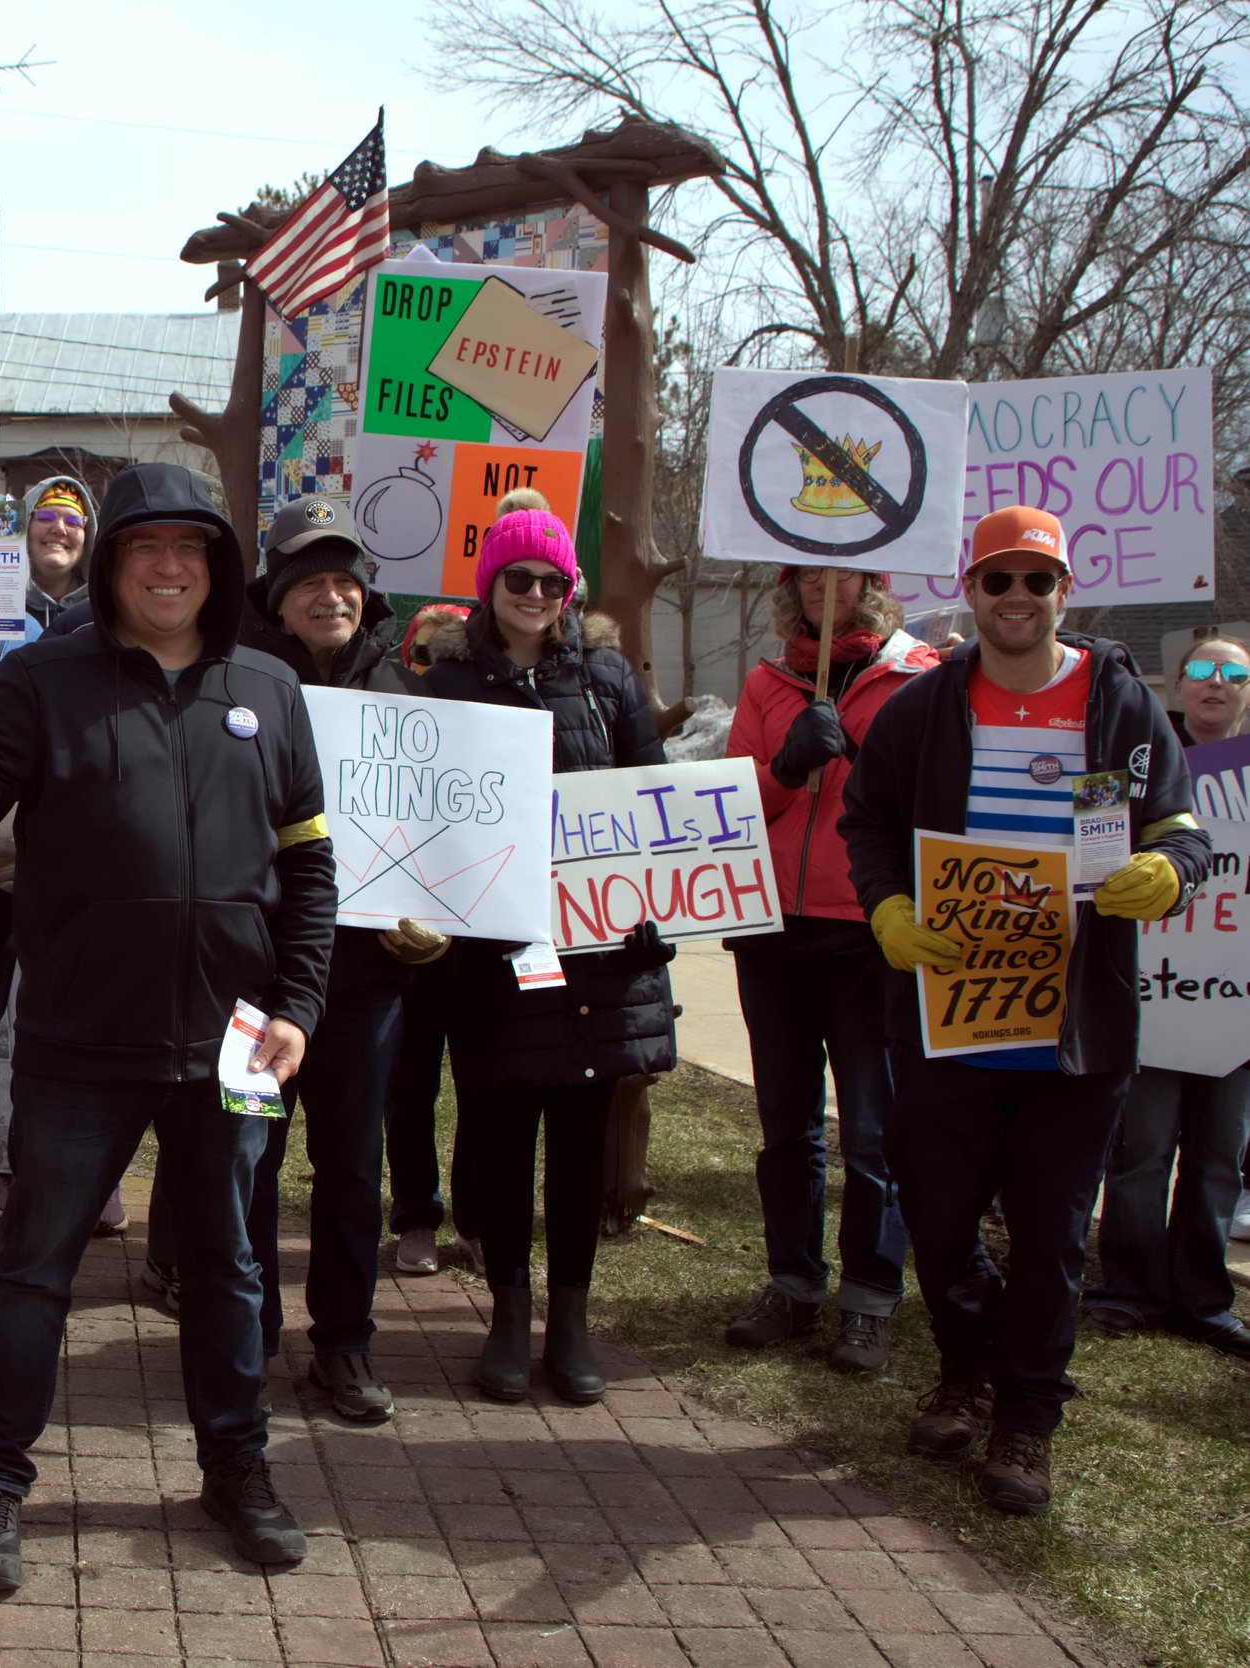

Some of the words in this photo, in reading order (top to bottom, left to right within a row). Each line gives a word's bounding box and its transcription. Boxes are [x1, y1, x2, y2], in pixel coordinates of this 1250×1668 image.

[381, 279, 452, 322] DROP
[456, 337, 561, 382] EPSTEIN
[378, 378, 453, 422] FILES
[483, 463, 538, 497] NOT
[1095, 452, 1205, 516] OUR
[1022, 528, 1056, 548] KTM
[361, 703, 440, 763] NO
[339, 759, 505, 825] KINGS
[1080, 817, 1102, 825] BRAD
[1080, 821, 1125, 836] SMITH
[933, 857, 1039, 894] No
[551, 858, 773, 947] NOUGH
[928, 898, 1063, 942] Kings
[941, 972, 1061, 1027] 1776
[972, 1027, 1032, 1041] NOKINGS.ORG
